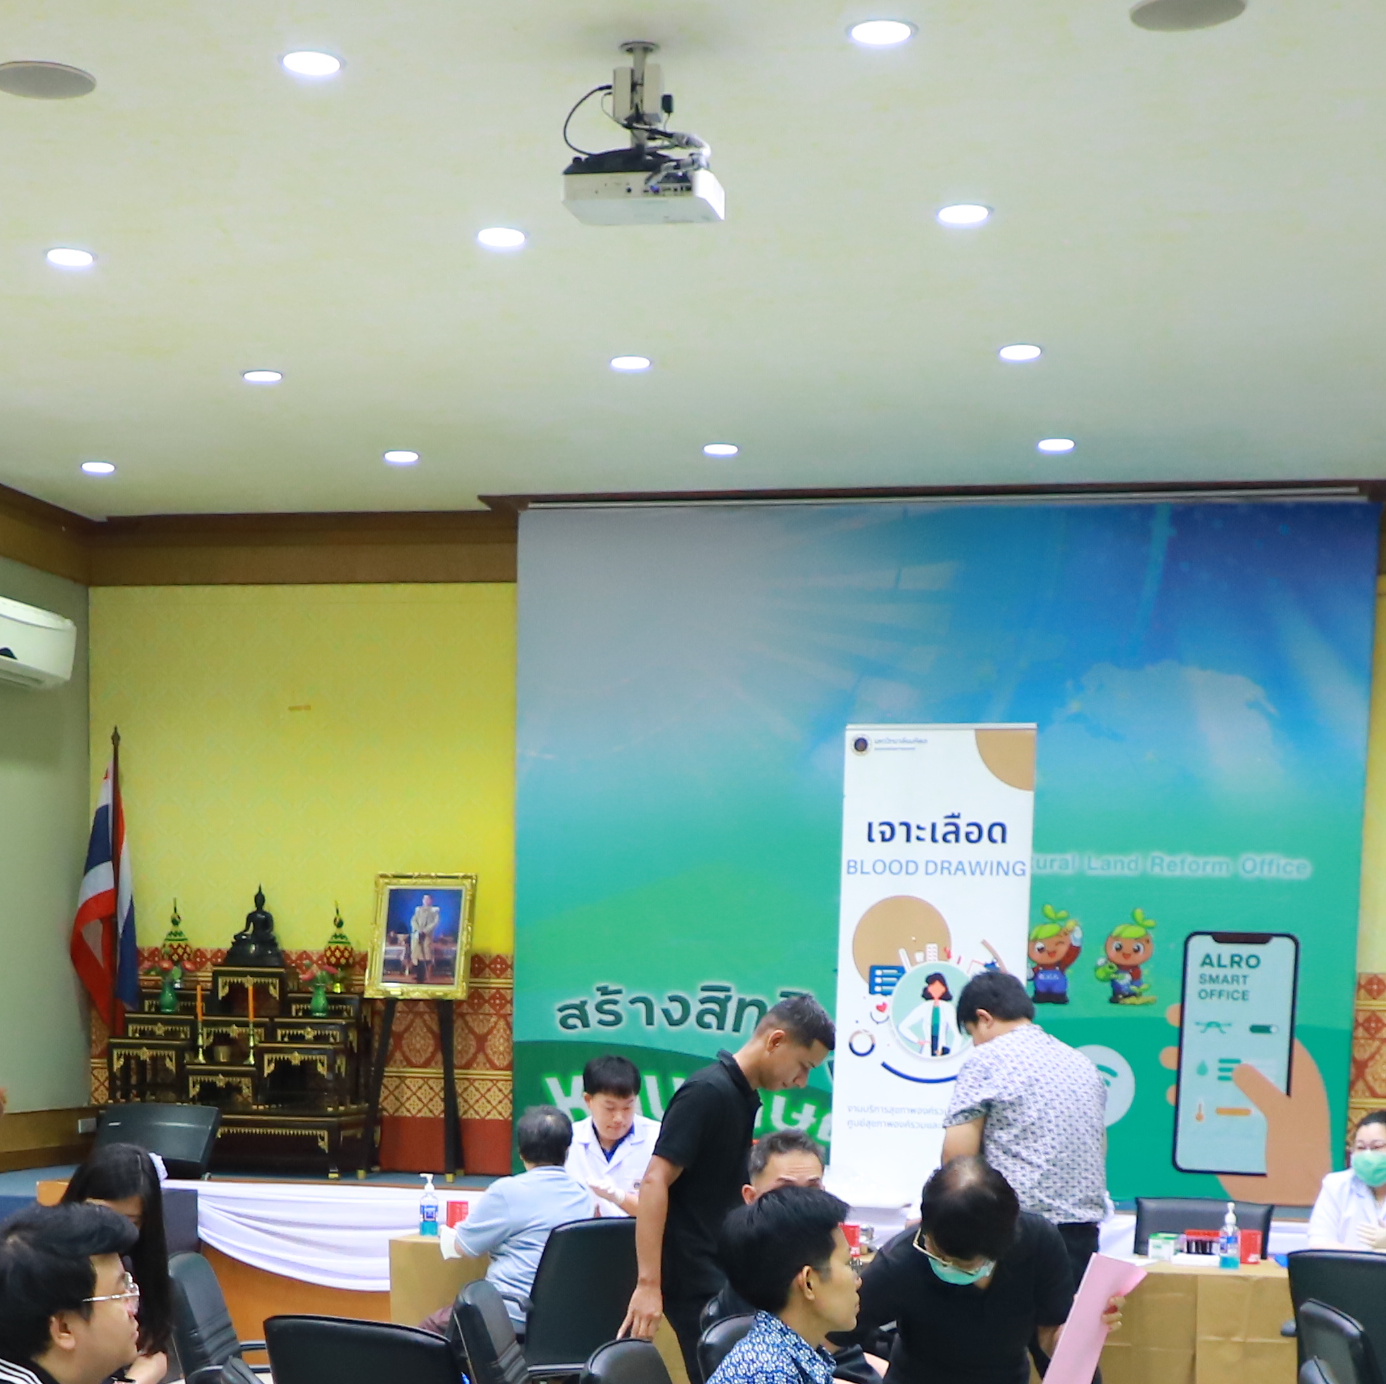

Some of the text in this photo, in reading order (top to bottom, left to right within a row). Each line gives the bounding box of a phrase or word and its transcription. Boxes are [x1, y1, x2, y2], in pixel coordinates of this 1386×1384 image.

[866, 812, 1008, 844] เจาะเลือด
[846, 859, 1027, 877] BLOOD DRAWING
[1033, 853, 1308, 875] ural Land Reform Office
[1199, 952, 1262, 970] ALRO
[1198, 972, 1250, 986] SMART
[1197, 988, 1251, 1001] OFFICE
[556, 983, 813, 1035] สร้างสิท
